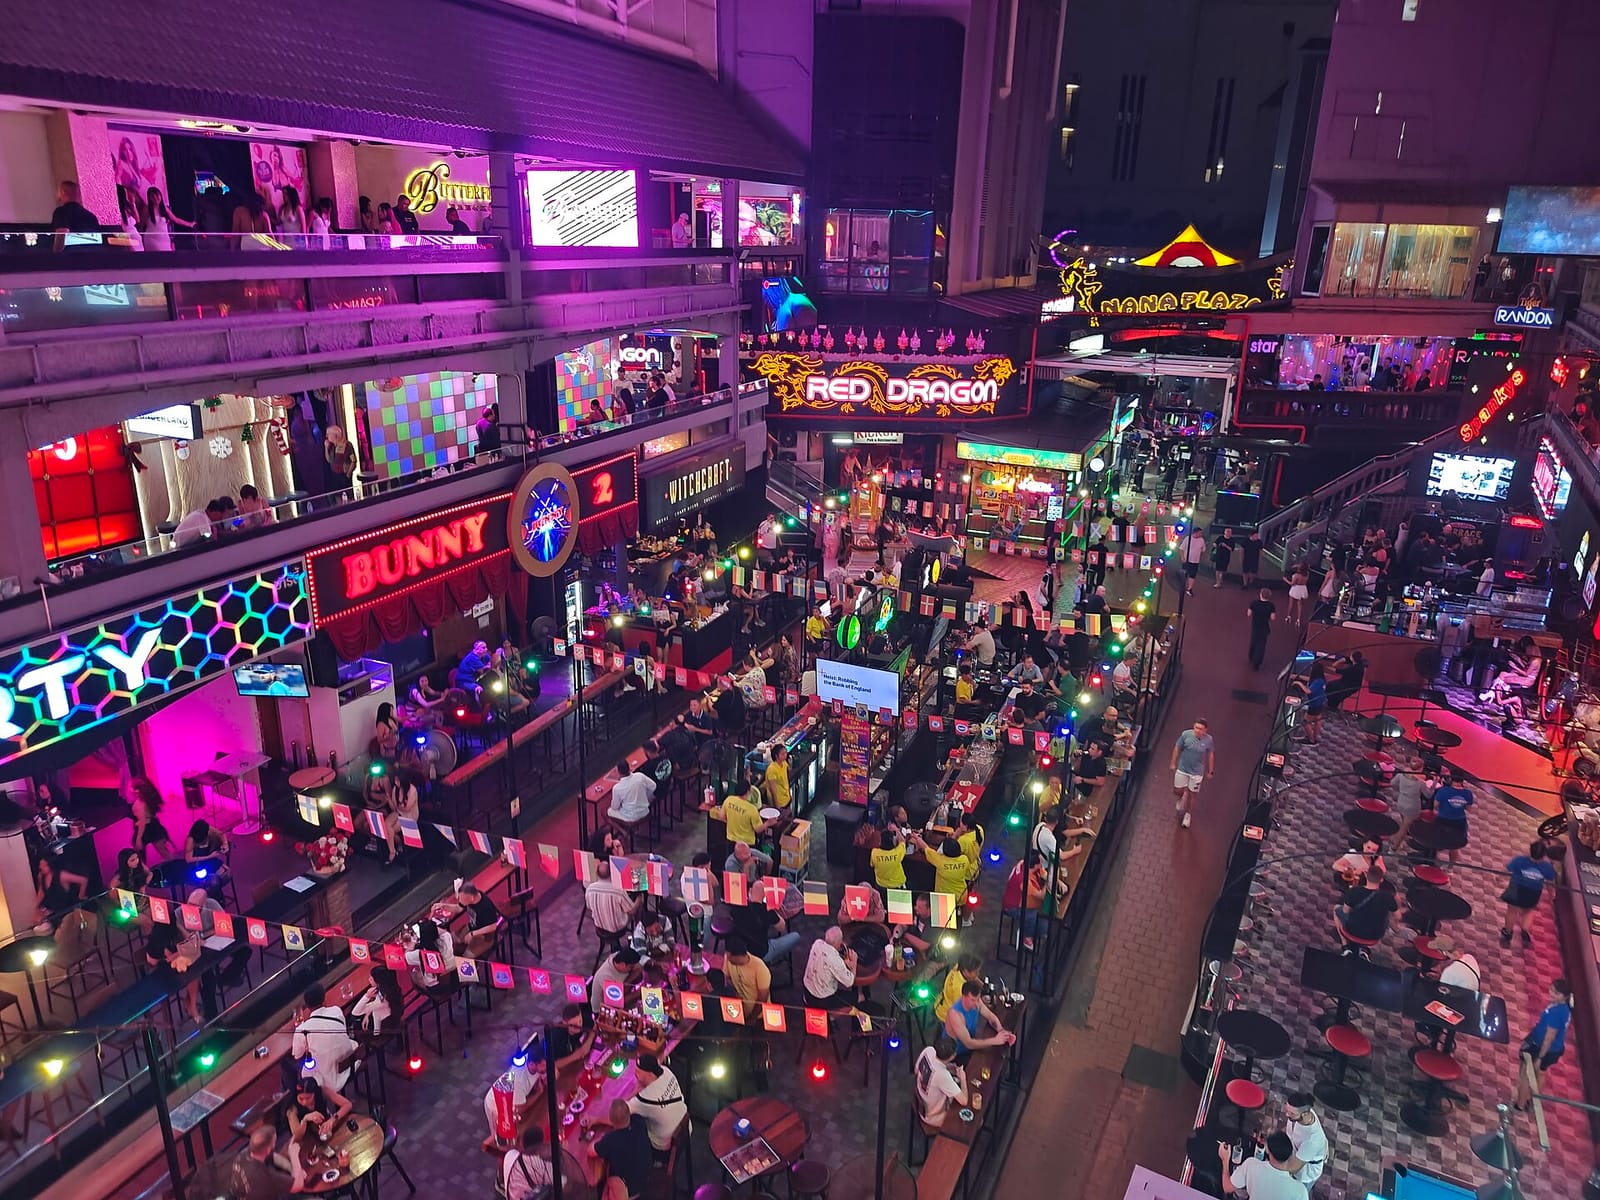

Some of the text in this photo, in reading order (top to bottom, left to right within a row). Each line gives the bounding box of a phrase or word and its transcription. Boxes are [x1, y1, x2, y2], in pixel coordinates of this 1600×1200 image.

[1101, 292, 1178, 313] NANA
[1520, 296, 1541, 311] Tiger
[1250, 339, 1278, 353] star
[806, 374, 998, 405] RED DRAGON
[592, 471, 614, 505] 2
[669, 458, 730, 505] WITCHCRAFT
[342, 511, 489, 599] BUNNY
[832, 681, 844, 689] Bank
[851, 685, 872, 693] England
[838, 676, 858, 686] Robbing
[876, 854, 898, 862] STAFF
[943, 862, 966, 871] STAFF
